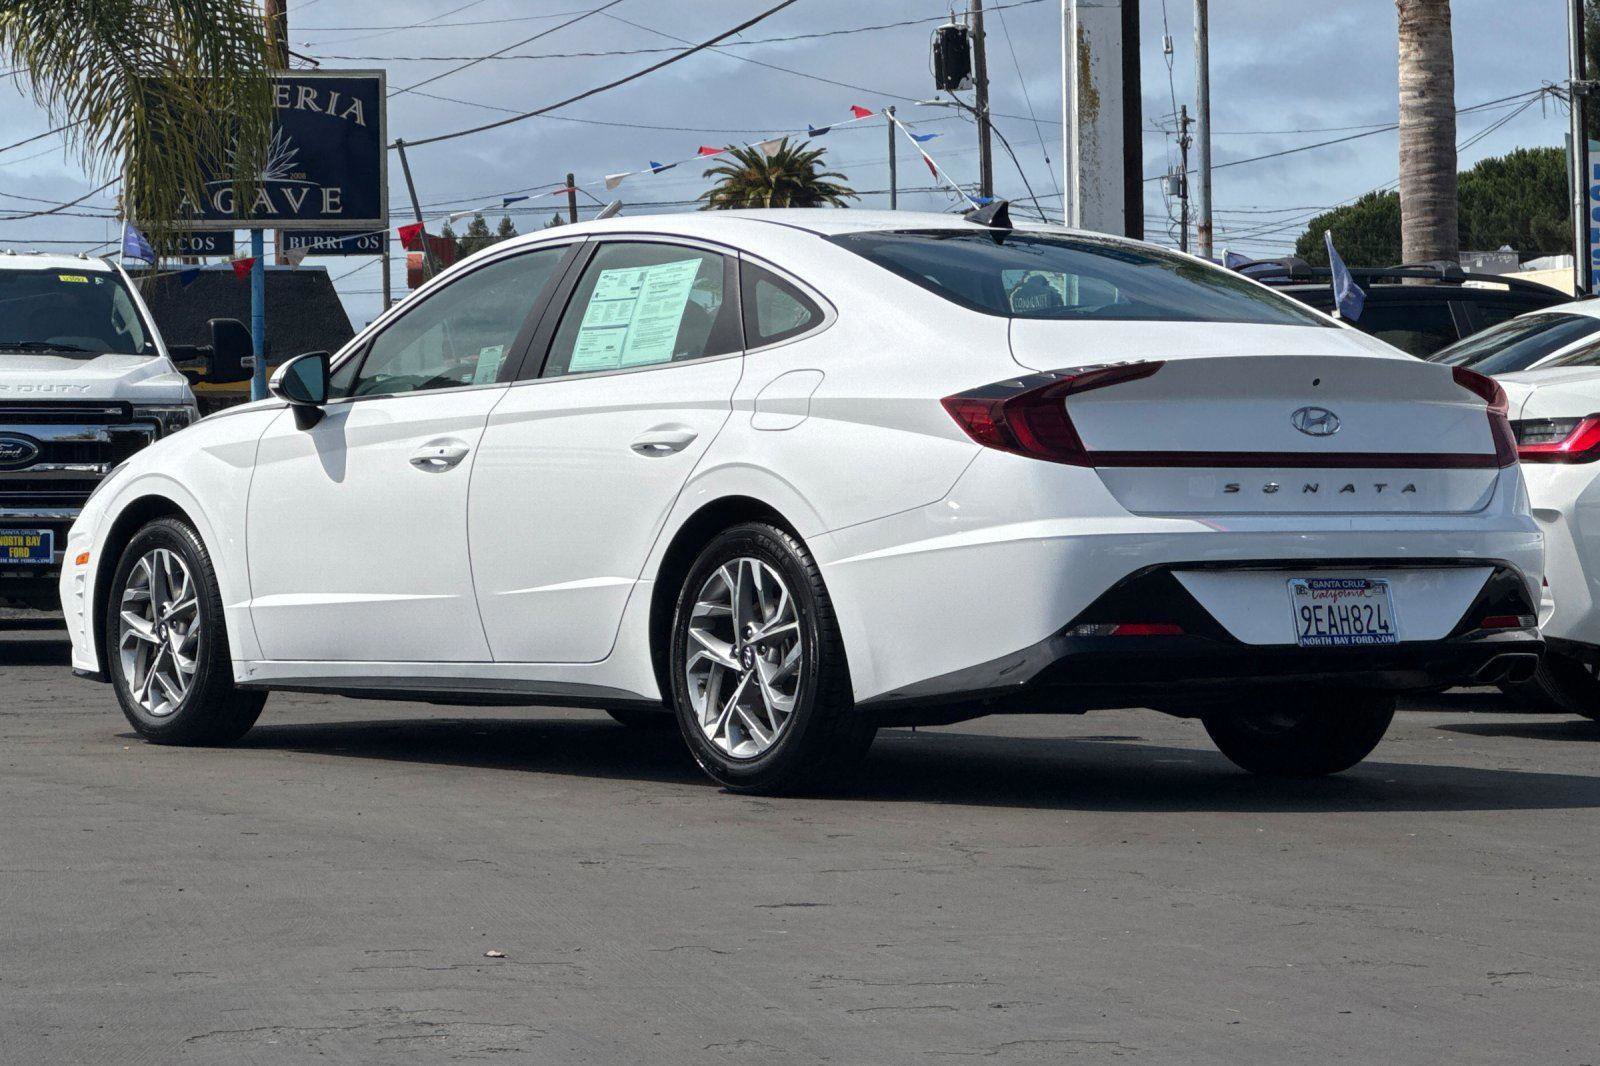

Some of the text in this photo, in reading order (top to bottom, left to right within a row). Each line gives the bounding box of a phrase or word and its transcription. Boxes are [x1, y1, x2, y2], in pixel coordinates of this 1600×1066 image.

[175, 187, 343, 214] AGAVE
[165, 236, 216, 251] ACOS
[289, 236, 379, 250] BURRIOS
[17, 384, 90, 393] DUTY
[1223, 483, 1417, 494] SONATA
[25, 536, 41, 546] BAY
[9, 547, 30, 558] FORD
[1313, 580, 1366, 588] SANTA CRUZ
[1312, 588, 1367, 603] California
[1300, 604, 1390, 635] 9EAH824
[1303, 635, 1394, 646] NORTH BAY FORD.COM
